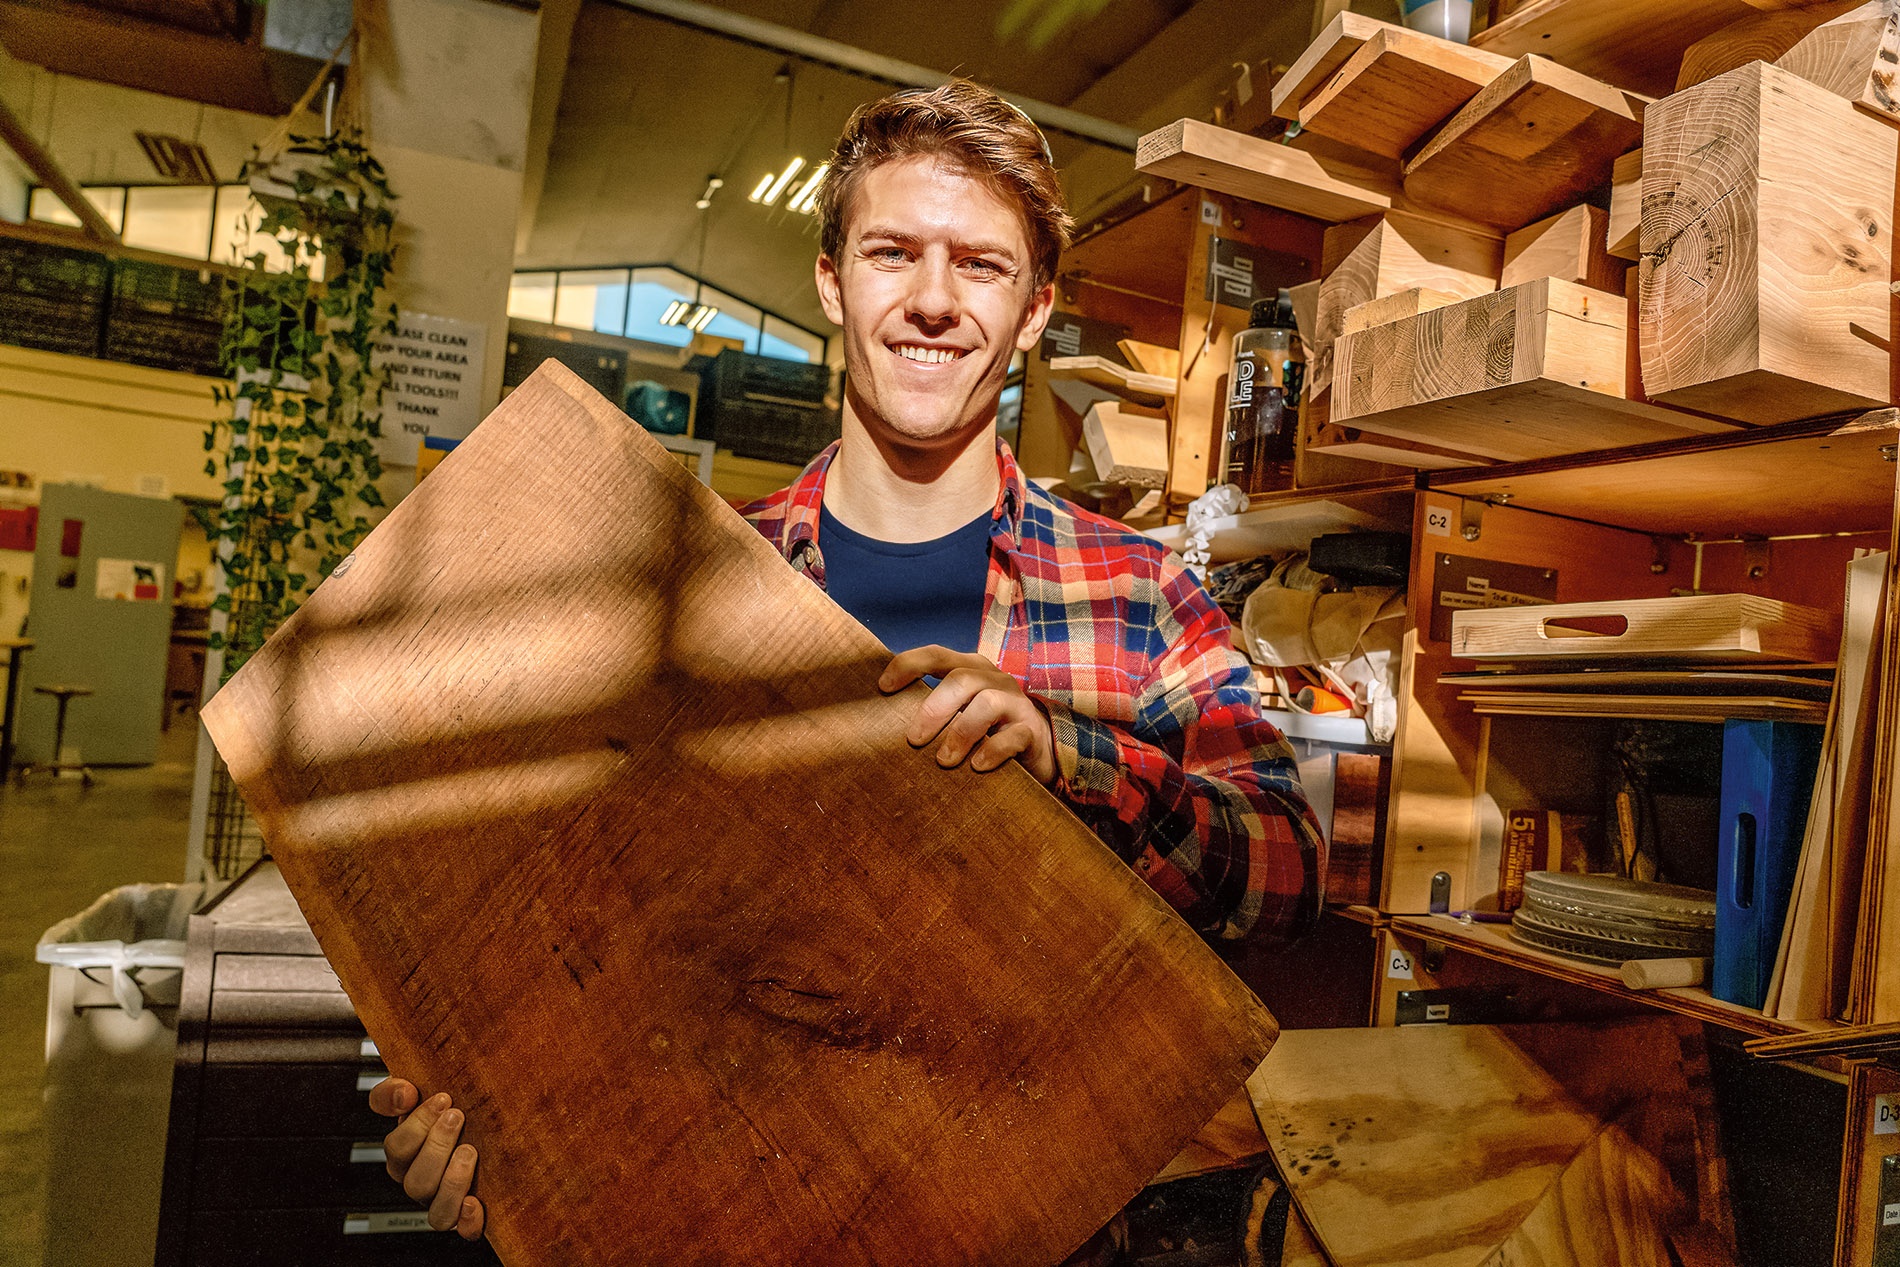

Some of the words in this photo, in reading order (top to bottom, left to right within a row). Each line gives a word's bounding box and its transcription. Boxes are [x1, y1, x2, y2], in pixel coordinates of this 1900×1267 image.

[428, 332, 468, 347] CLEAN
[398, 345, 432, 360] YOUR
[435, 351, 468, 365] AREA
[412, 366, 461, 382] RETURN
[405, 382, 459, 401] TOOLS!!!
[397, 401, 440, 417] THANK
[403, 422, 430, 436] YOU
[1429, 513, 1447, 528] C-2
[1512, 817, 1535, 831] 5
[1392, 958, 1410, 971] C-3
[1429, 1008, 1446, 1017] Name
[1880, 1105, 1900, 1122] D-3
[1885, 1210, 1899, 1220] Date
